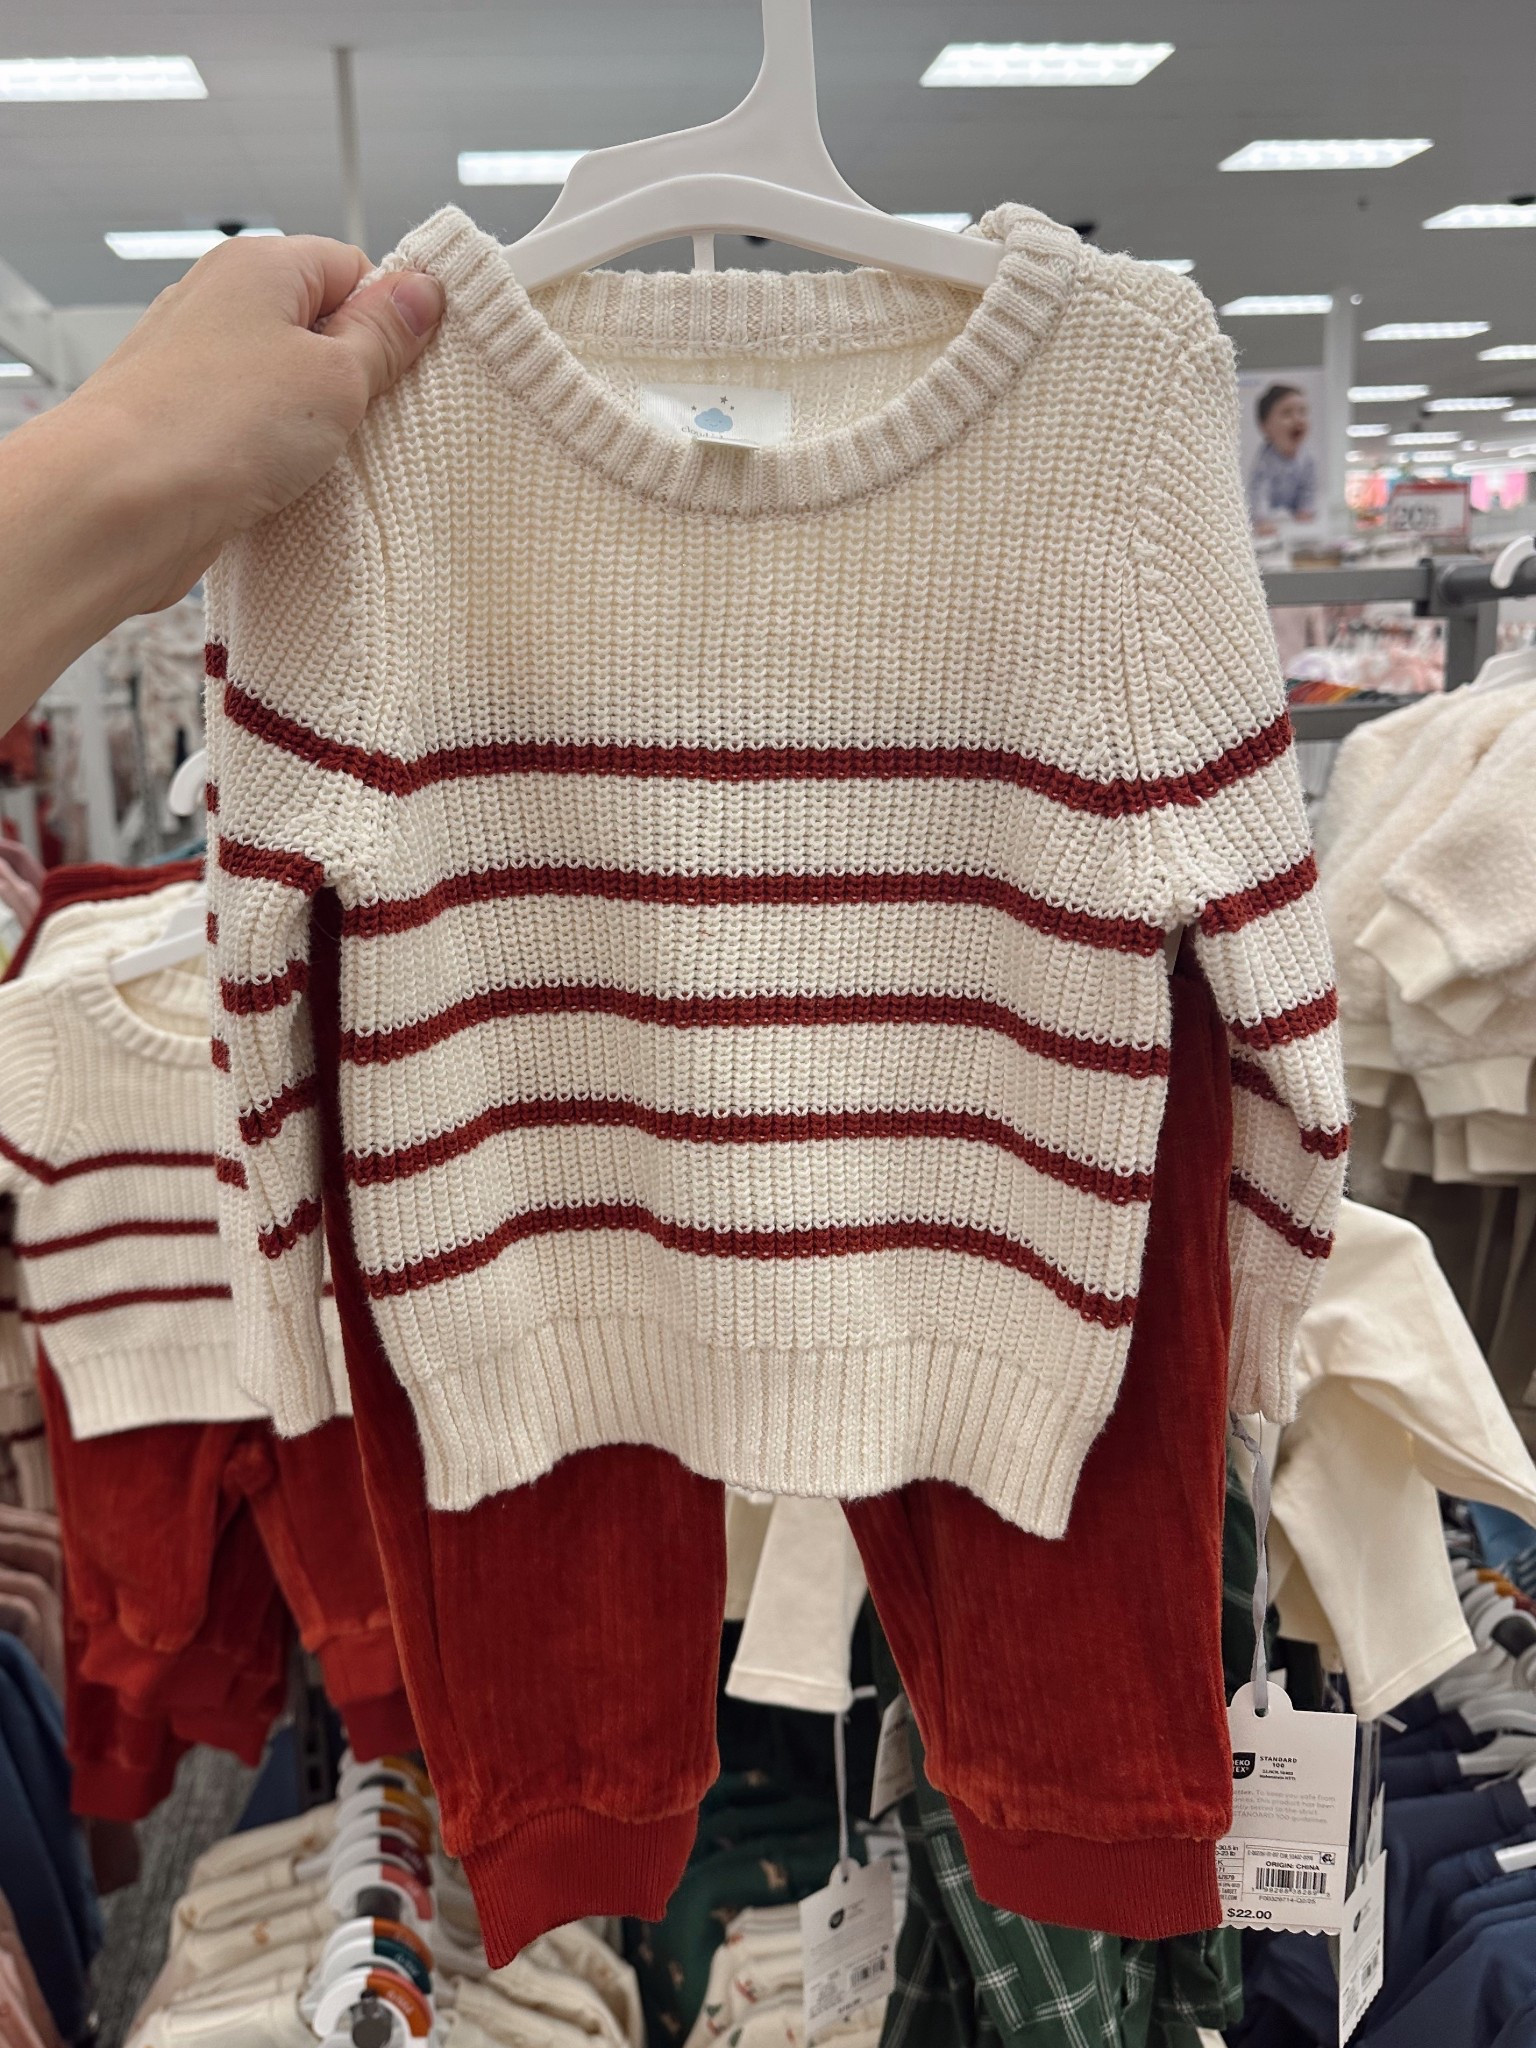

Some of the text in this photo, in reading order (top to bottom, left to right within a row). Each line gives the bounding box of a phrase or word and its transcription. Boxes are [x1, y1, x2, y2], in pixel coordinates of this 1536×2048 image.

[1265, 1860, 1320, 1871] ORIGIN: CHINA
[1227, 1908, 1272, 1920] $22.00
